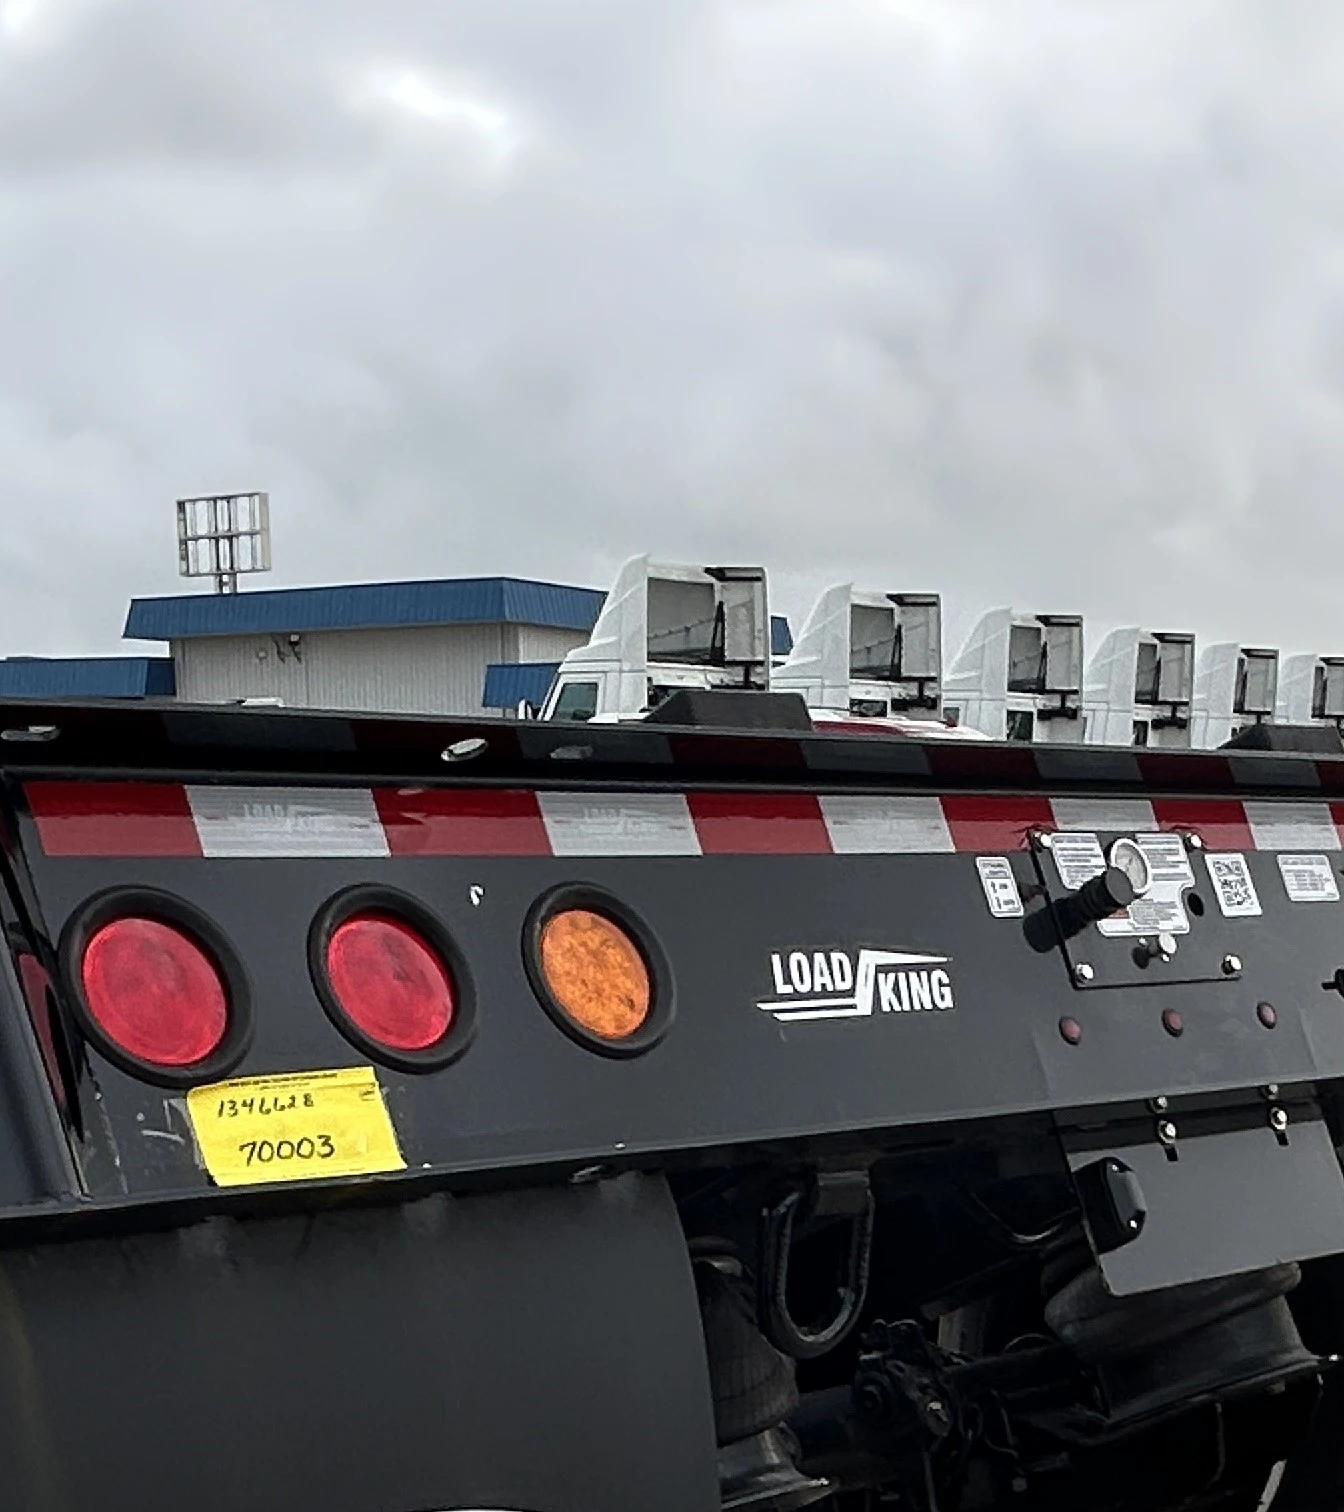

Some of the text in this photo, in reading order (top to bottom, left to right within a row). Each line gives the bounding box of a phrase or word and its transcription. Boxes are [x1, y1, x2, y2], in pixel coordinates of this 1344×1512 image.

[771, 951, 954, 1012] LOAD KING
[238, 1134, 336, 1167] 70003
